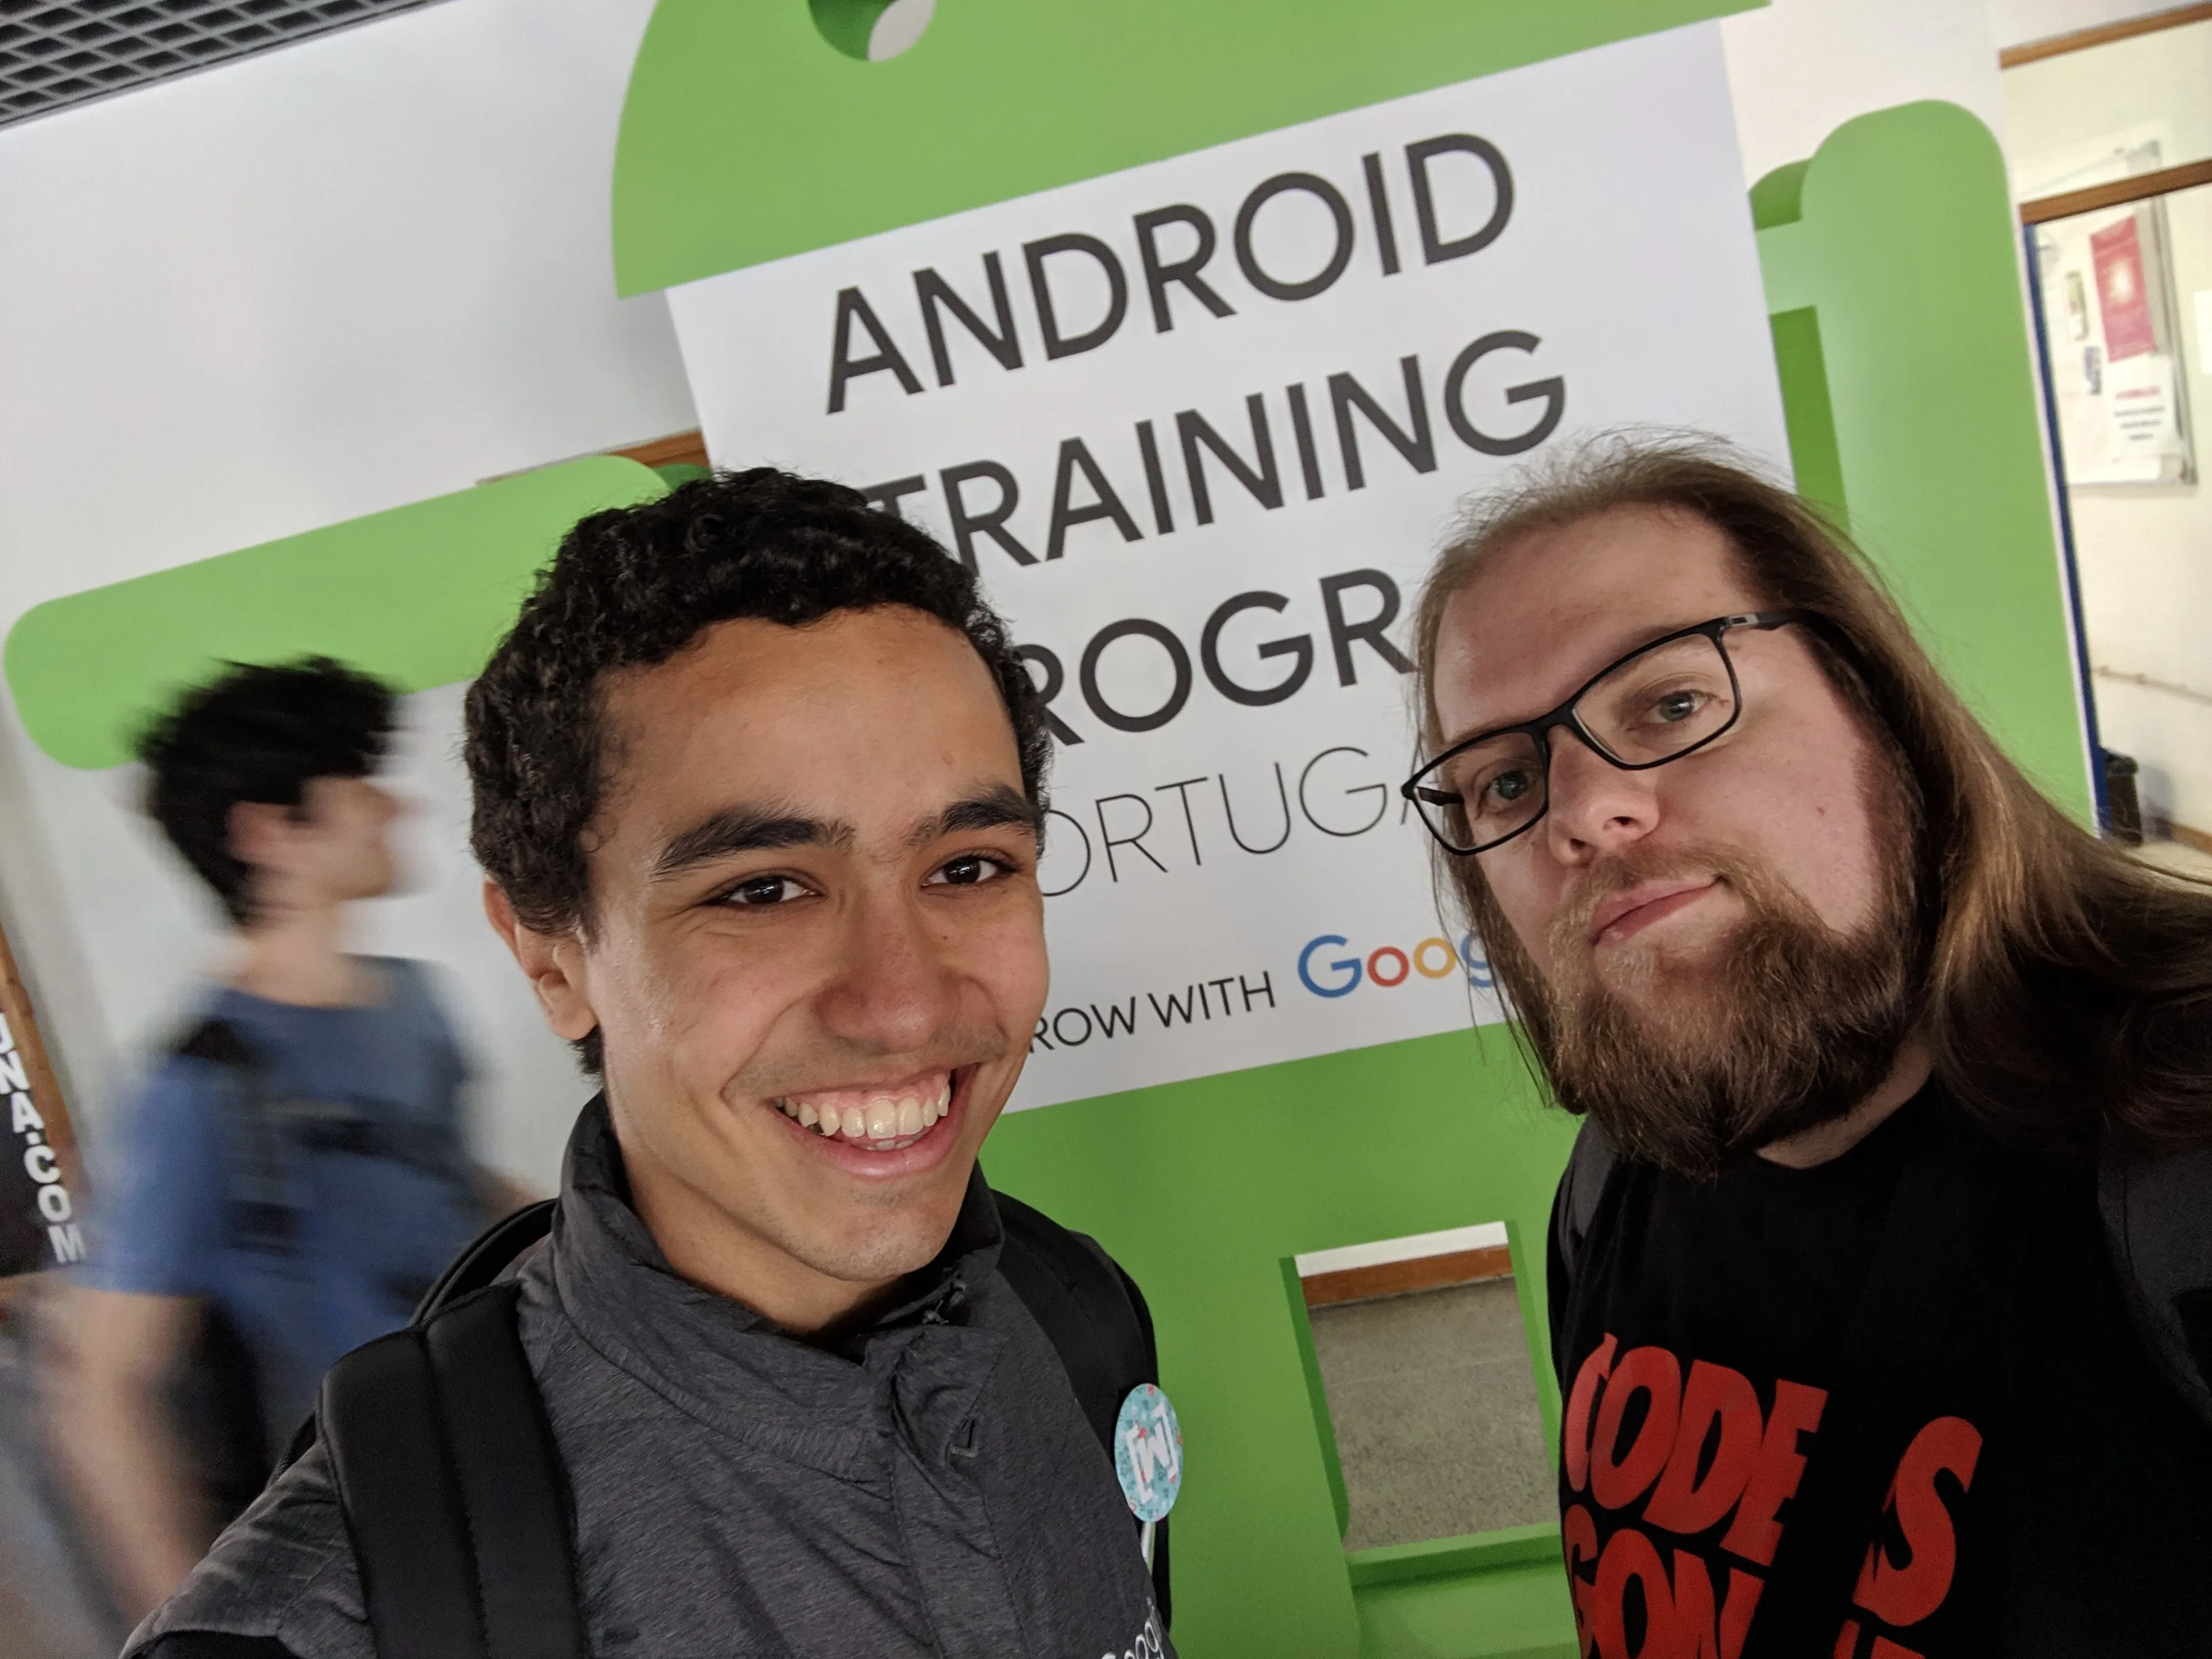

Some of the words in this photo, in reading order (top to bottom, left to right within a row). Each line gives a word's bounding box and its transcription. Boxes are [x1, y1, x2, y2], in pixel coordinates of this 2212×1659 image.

[826, 132, 1515, 415] ANDROID
[1012, 568, 1420, 747] ROGR
[1146, 970, 1276, 1028] WITH
[1297, 934, 1494, 999] Goog
